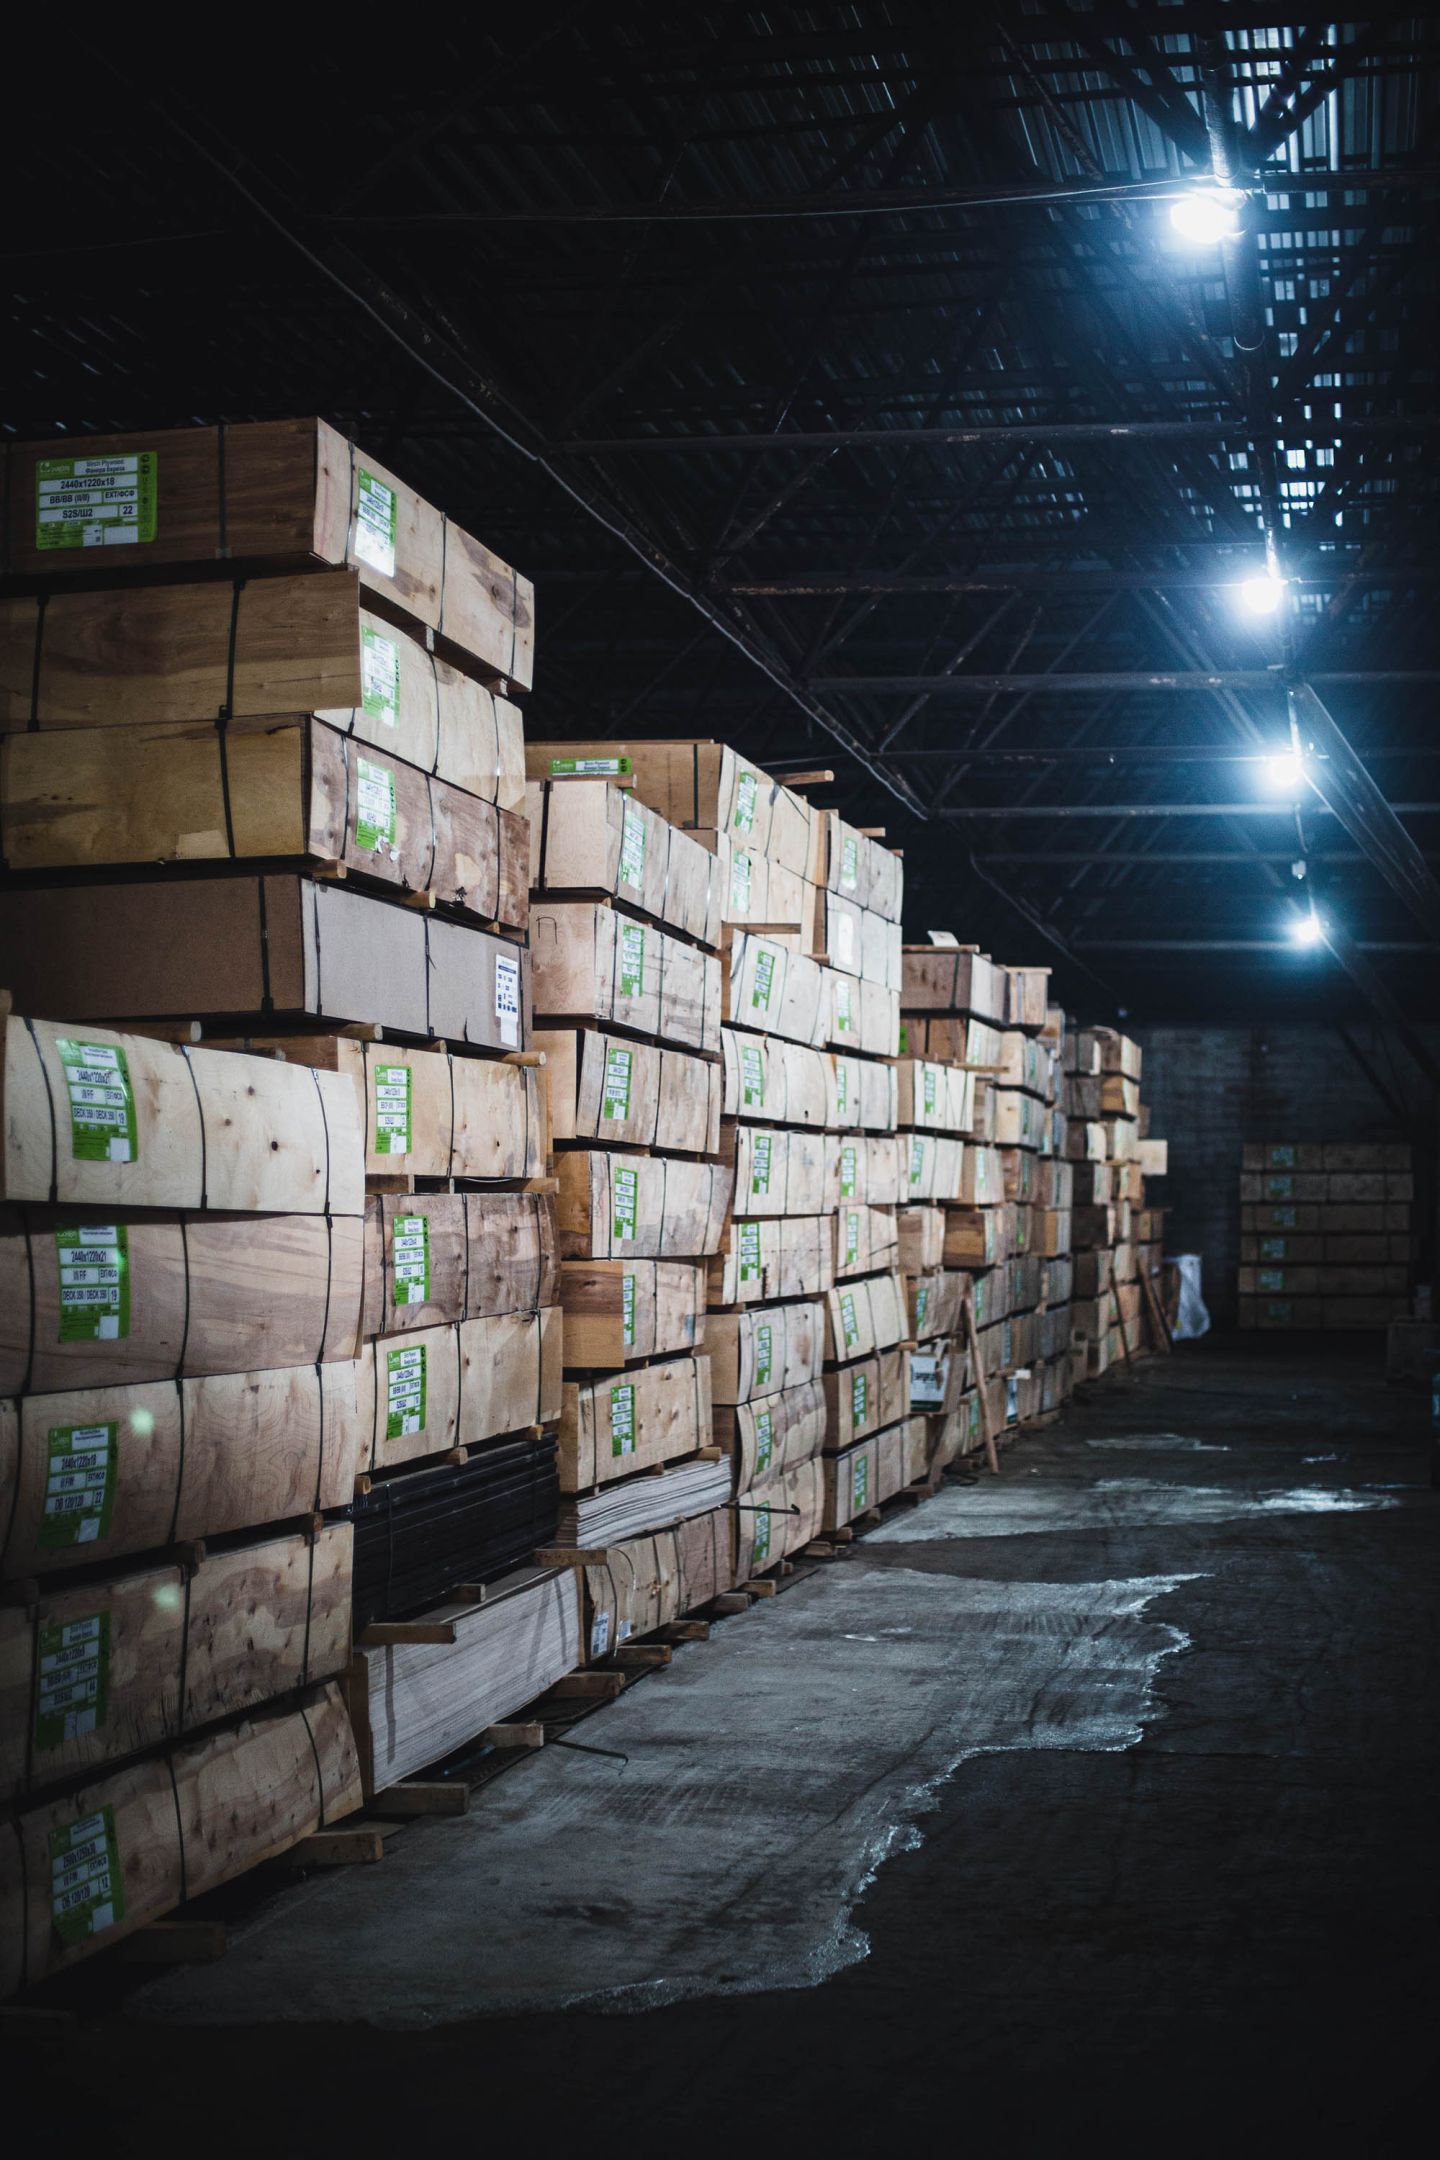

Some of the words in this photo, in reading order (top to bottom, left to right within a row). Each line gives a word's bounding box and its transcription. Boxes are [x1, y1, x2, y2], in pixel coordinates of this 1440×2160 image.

[61, 477, 115, 490] 2440x1220x18
[105, 490, 135, 498] EXT/ФСФ
[62, 508, 92, 518] S2S/Ш2
[123, 505, 133, 515] 22
